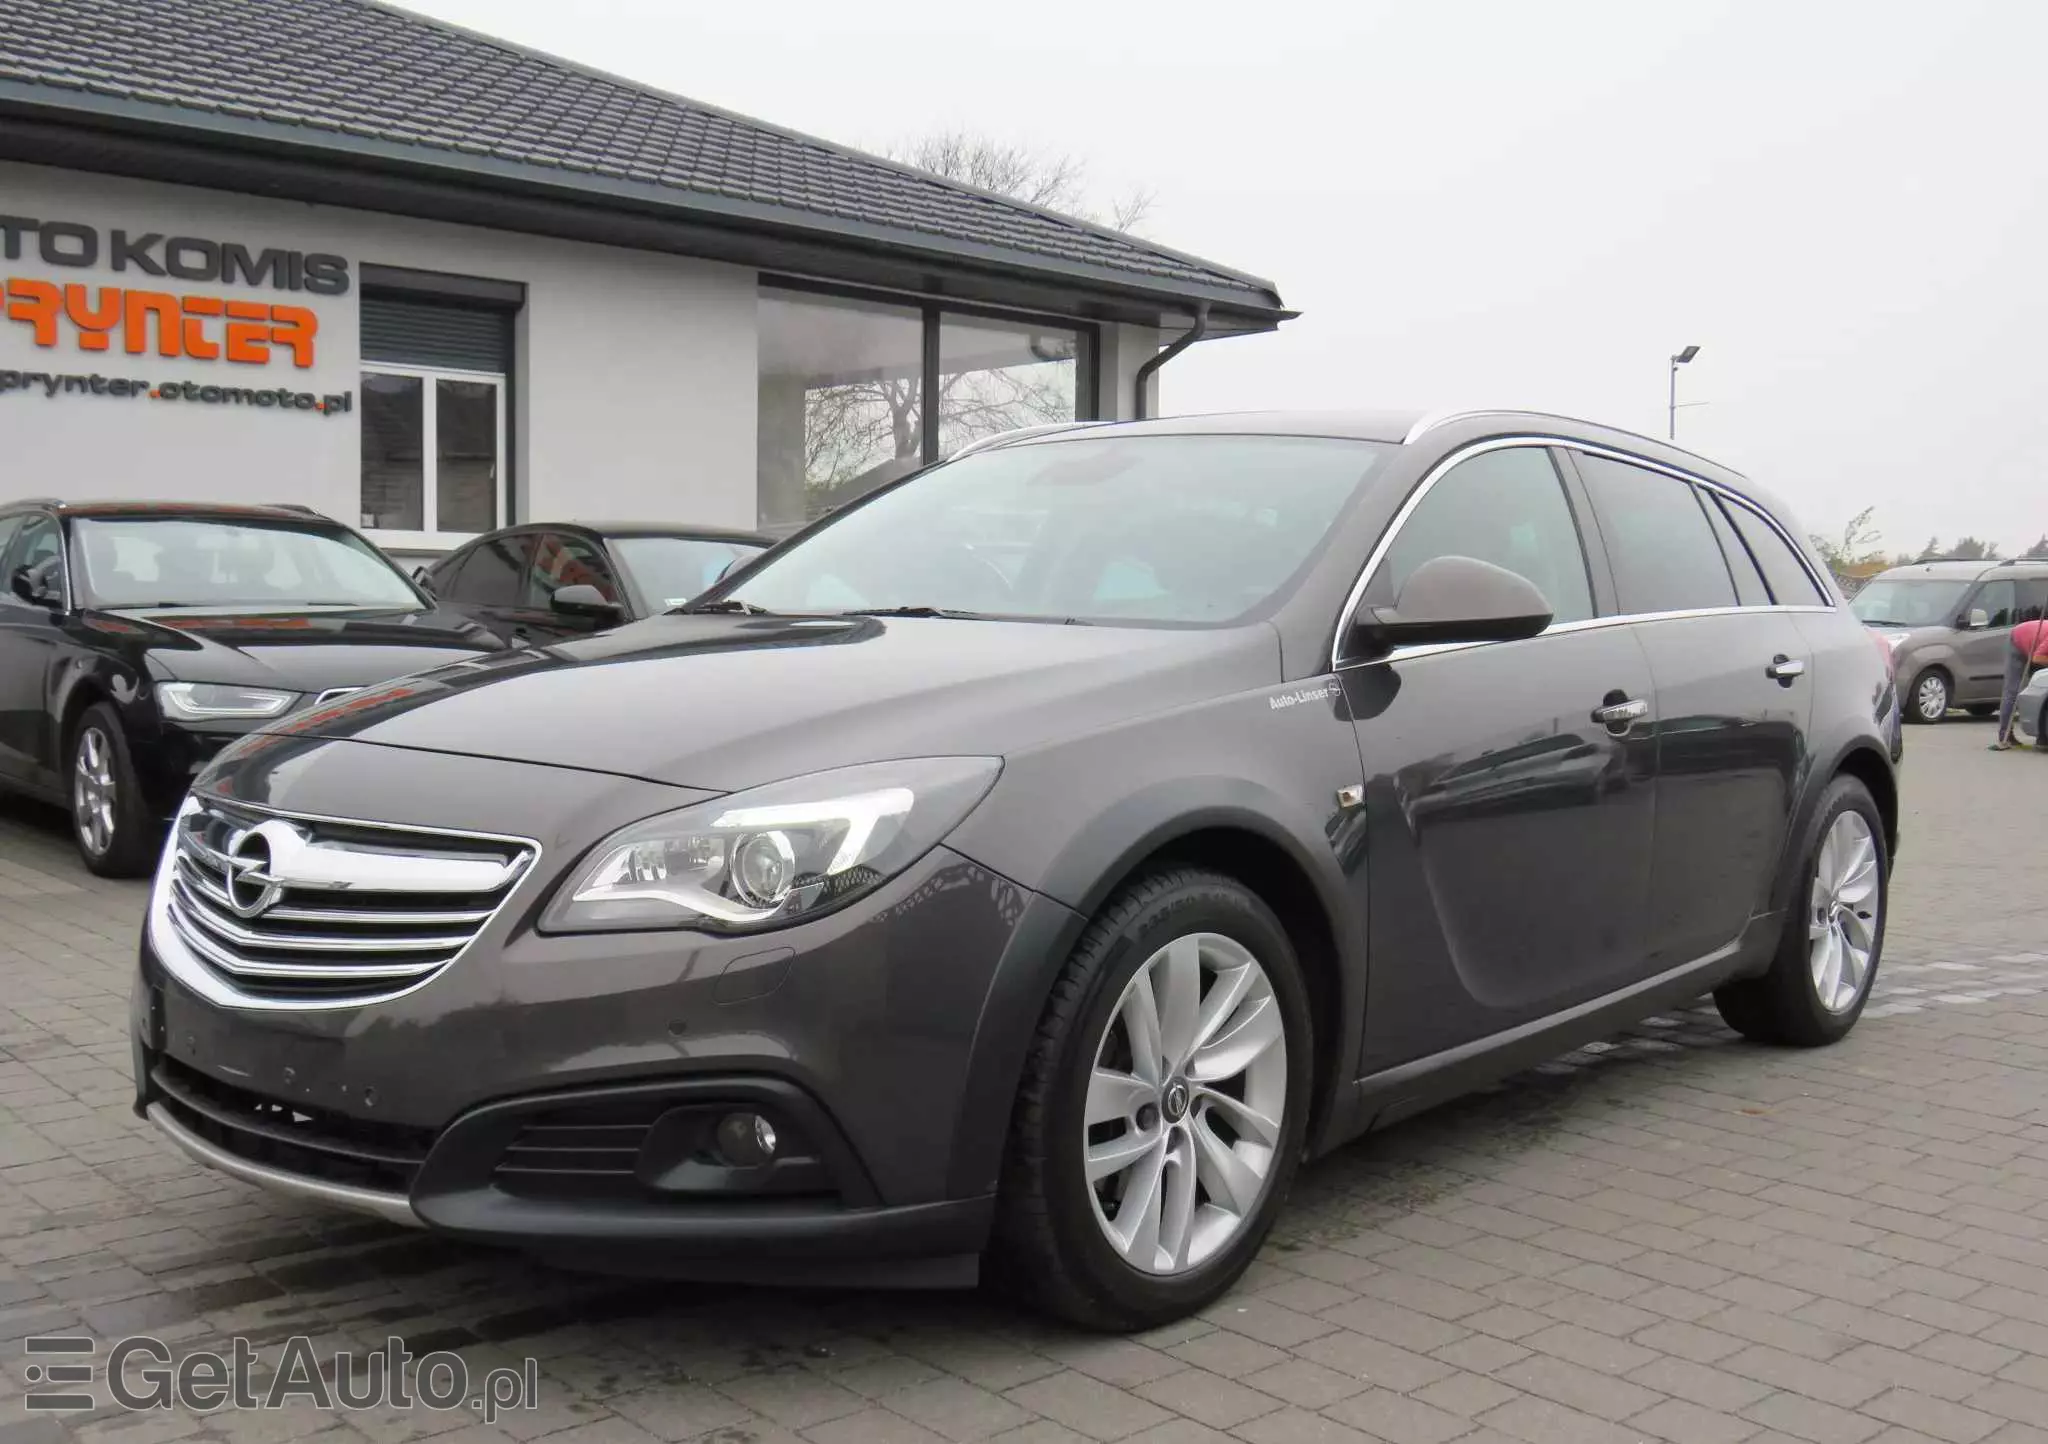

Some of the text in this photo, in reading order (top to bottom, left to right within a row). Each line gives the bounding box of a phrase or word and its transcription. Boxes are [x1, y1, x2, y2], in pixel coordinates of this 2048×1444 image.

[0, 215, 350, 295] TO KOMIS
[0, 277, 318, 368] RYNTER
